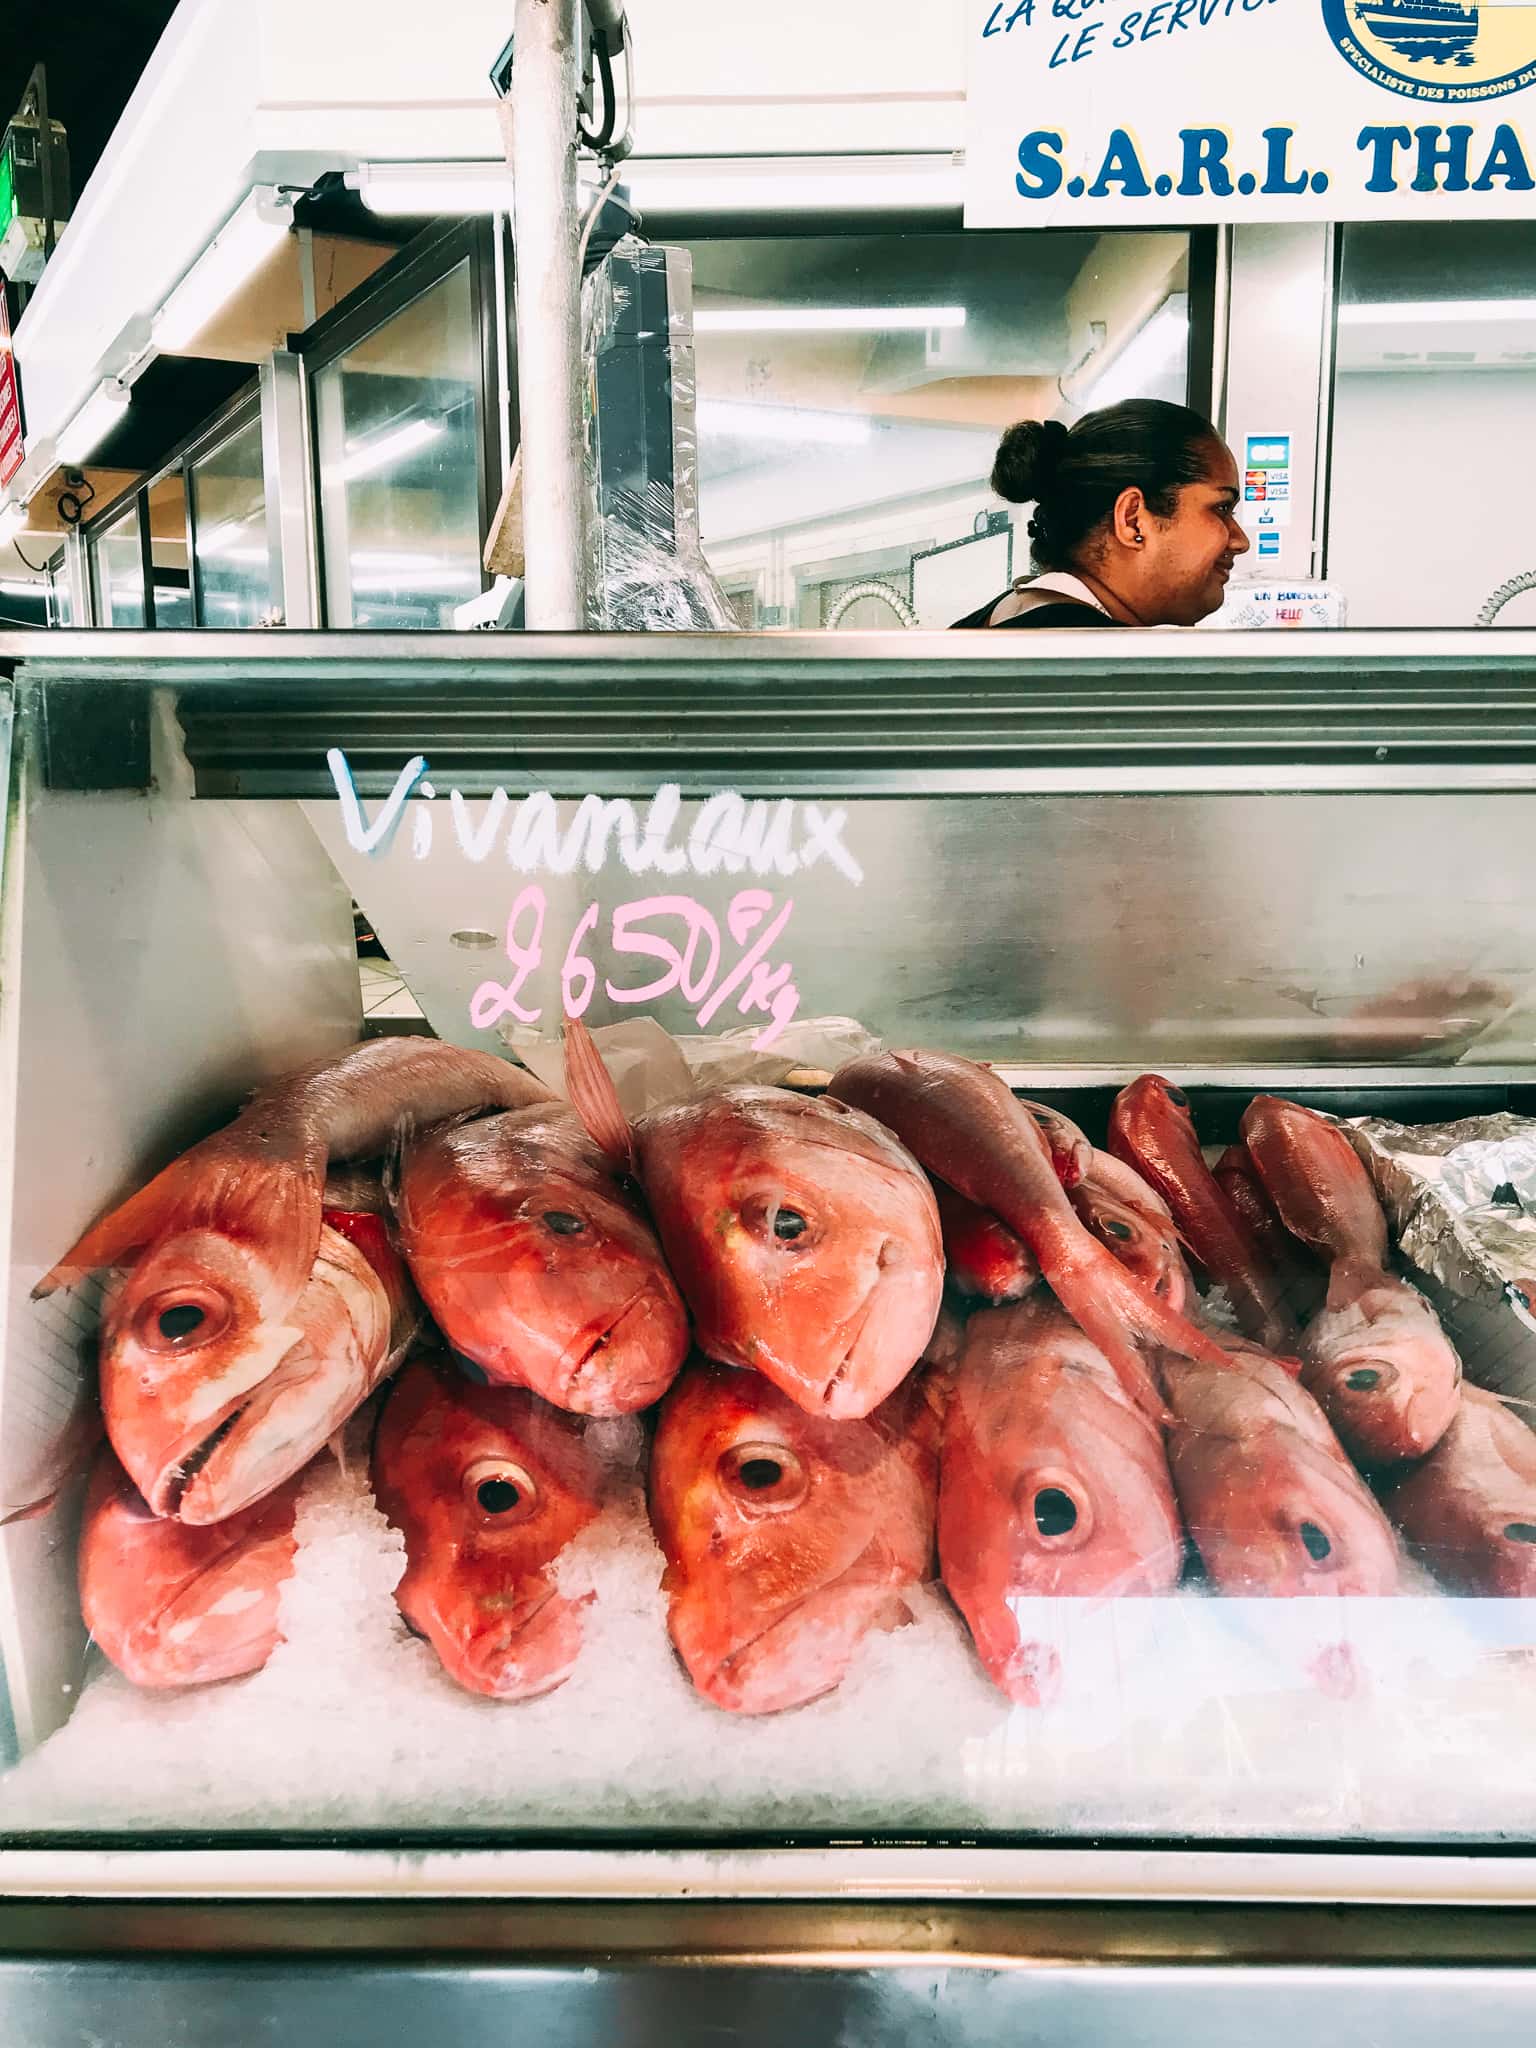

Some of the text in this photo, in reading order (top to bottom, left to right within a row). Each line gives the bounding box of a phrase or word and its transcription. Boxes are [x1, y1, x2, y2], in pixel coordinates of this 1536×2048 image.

[982, 0, 1036, 38] LA
[1048, 22, 1104, 69] LE
[1339, 37, 1415, 95] SPECIALISTE
[1417, 85, 1445, 99] DES
[1447, 78, 1517, 100] POISSONS
[1015, 122, 1536, 199] S.A.R.L. THA
[1275, 607, 1304, 620] HELLO
[327, 747, 864, 887] Vivaneaux
